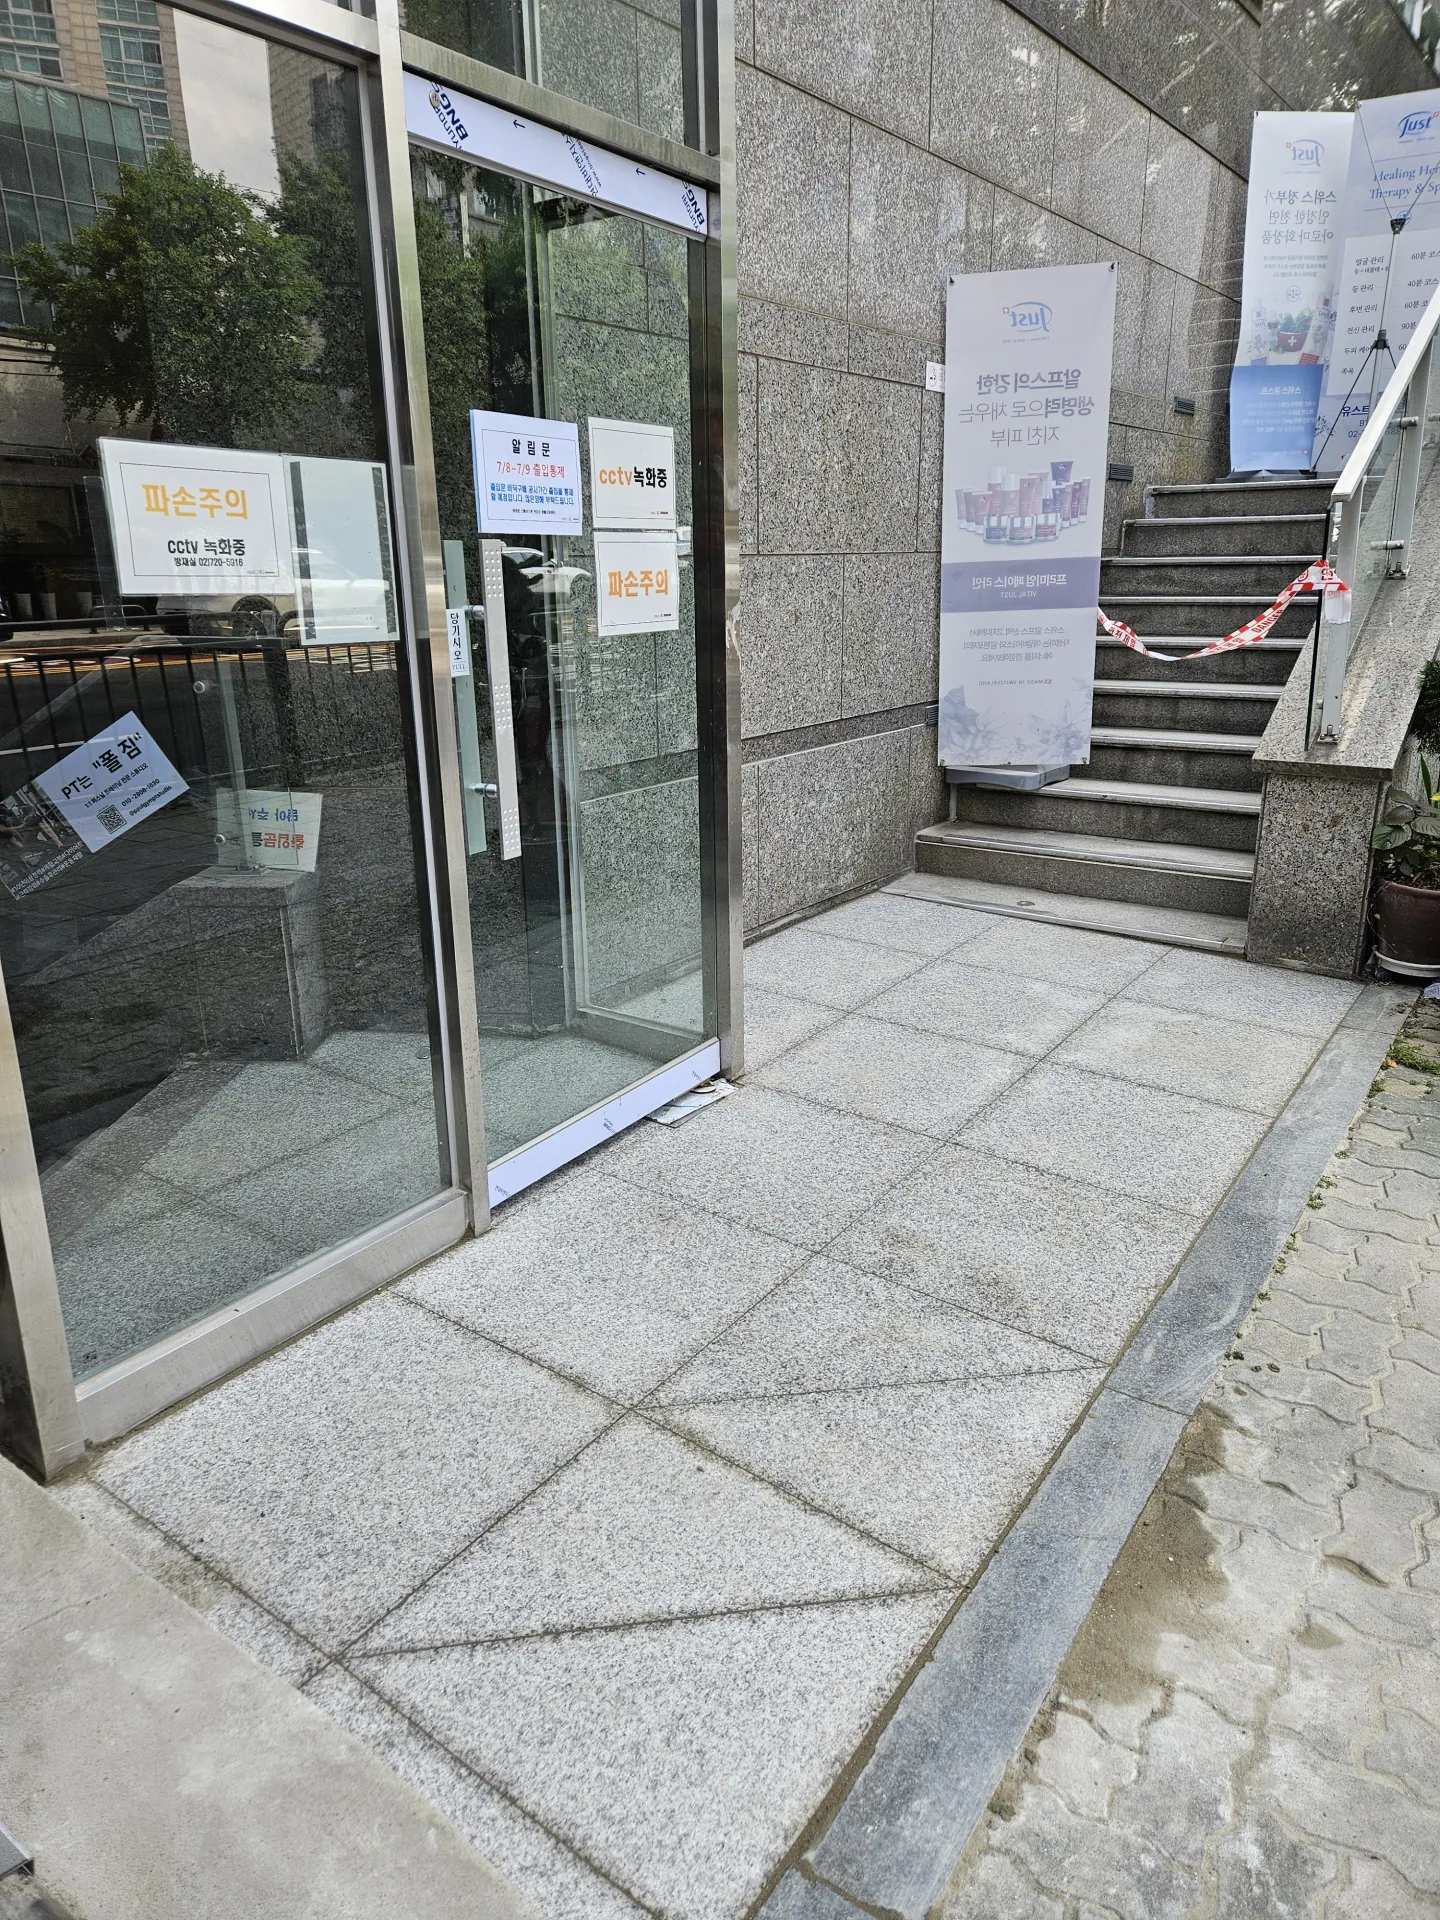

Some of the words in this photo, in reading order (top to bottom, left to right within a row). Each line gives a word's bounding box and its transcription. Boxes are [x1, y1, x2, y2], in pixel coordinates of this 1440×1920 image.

[1399, 114, 1433, 139] Just
[1373, 167, 1416, 182] Healing
[1370, 187, 1413, 200] Therapy
[1370, 256, 1384, 265] 관리
[1411, 252, 1426, 260] 60분
[1360, 284, 1374, 292] 관리
[1408, 279, 1423, 287] 40분
[1424, 278, 1439, 286] 코스
[1364, 304, 1378, 312] 관리
[1347, 326, 1360, 335] 전신
[1362, 325, 1375, 333] 관리
[1402, 322, 1417, 330] 90분
[512, 438, 521, 455] 알
[527, 440, 536, 456] 림
[542, 442, 551, 457] 문
[496, 461, 531, 476] 7/8~7/9
[533, 463, 565, 479] 출입통제
[141, 484, 248, 520] 파손주의
[167, 539, 198, 555] cctv
[204, 538, 246, 556] 녹화중
[174, 557, 197, 567] 방재실
[608, 570, 669, 598] 파손주의
[450, 612, 463, 661] 당기시오
[103, 780, 122, 796] 트레이닝
[120, 774, 132, 785] 전문
[130, 763, 148, 778] 스튜디오
[61, 775, 93, 800] PT는
[275, 807, 299, 822] 닫아
[251, 831, 305, 850] 출입문을
